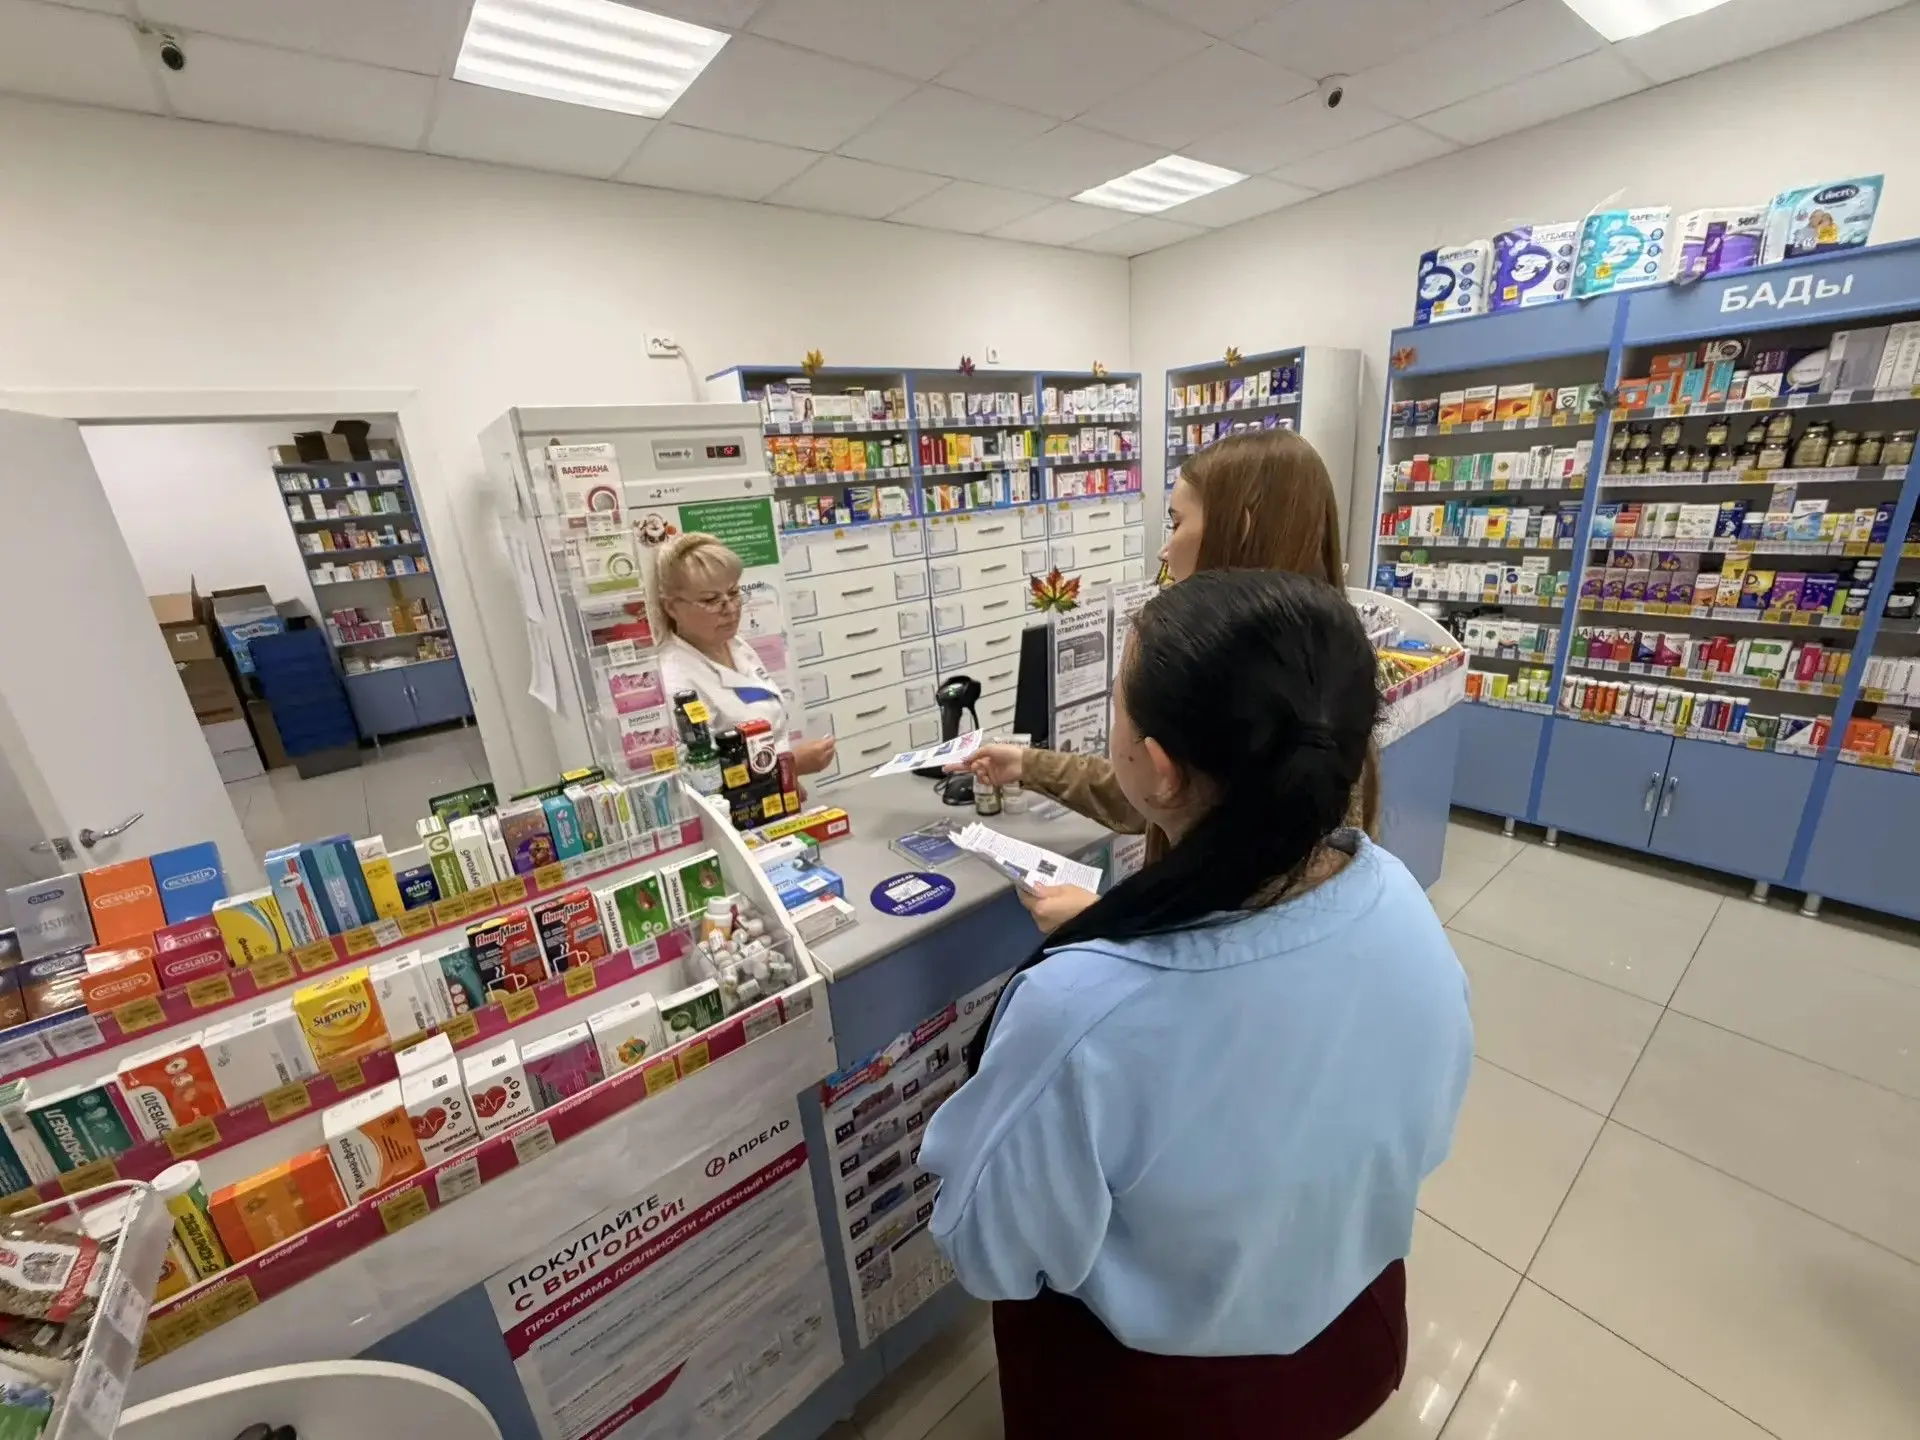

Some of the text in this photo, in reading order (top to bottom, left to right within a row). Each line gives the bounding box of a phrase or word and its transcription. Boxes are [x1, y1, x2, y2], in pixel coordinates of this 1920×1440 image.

[1819, 186, 1857, 202] Liberty
[1738, 214, 1760, 227] seni
[1720, 274, 1853, 313] БАДы
[562, 464, 609, 475] ВАЛЕРИАНА
[605, 900, 623, 953] епаинтенс
[313, 998, 368, 1028] Supradyn
[728, 1119, 790, 1164] АПРЕЛЬ
[259, 1236, 309, 1269] Выгодно!
[507, 1193, 661, 1296] ПОКУПАЙТЕ
[514, 1292, 536, 1312] С
[543, 1197, 685, 1296] ВЫГОДОЙ!
[524, 1275, 613, 1337] ПРОГРАММА
[614, 1218, 698, 1281] ЛОЯЛЬНОСТИ
